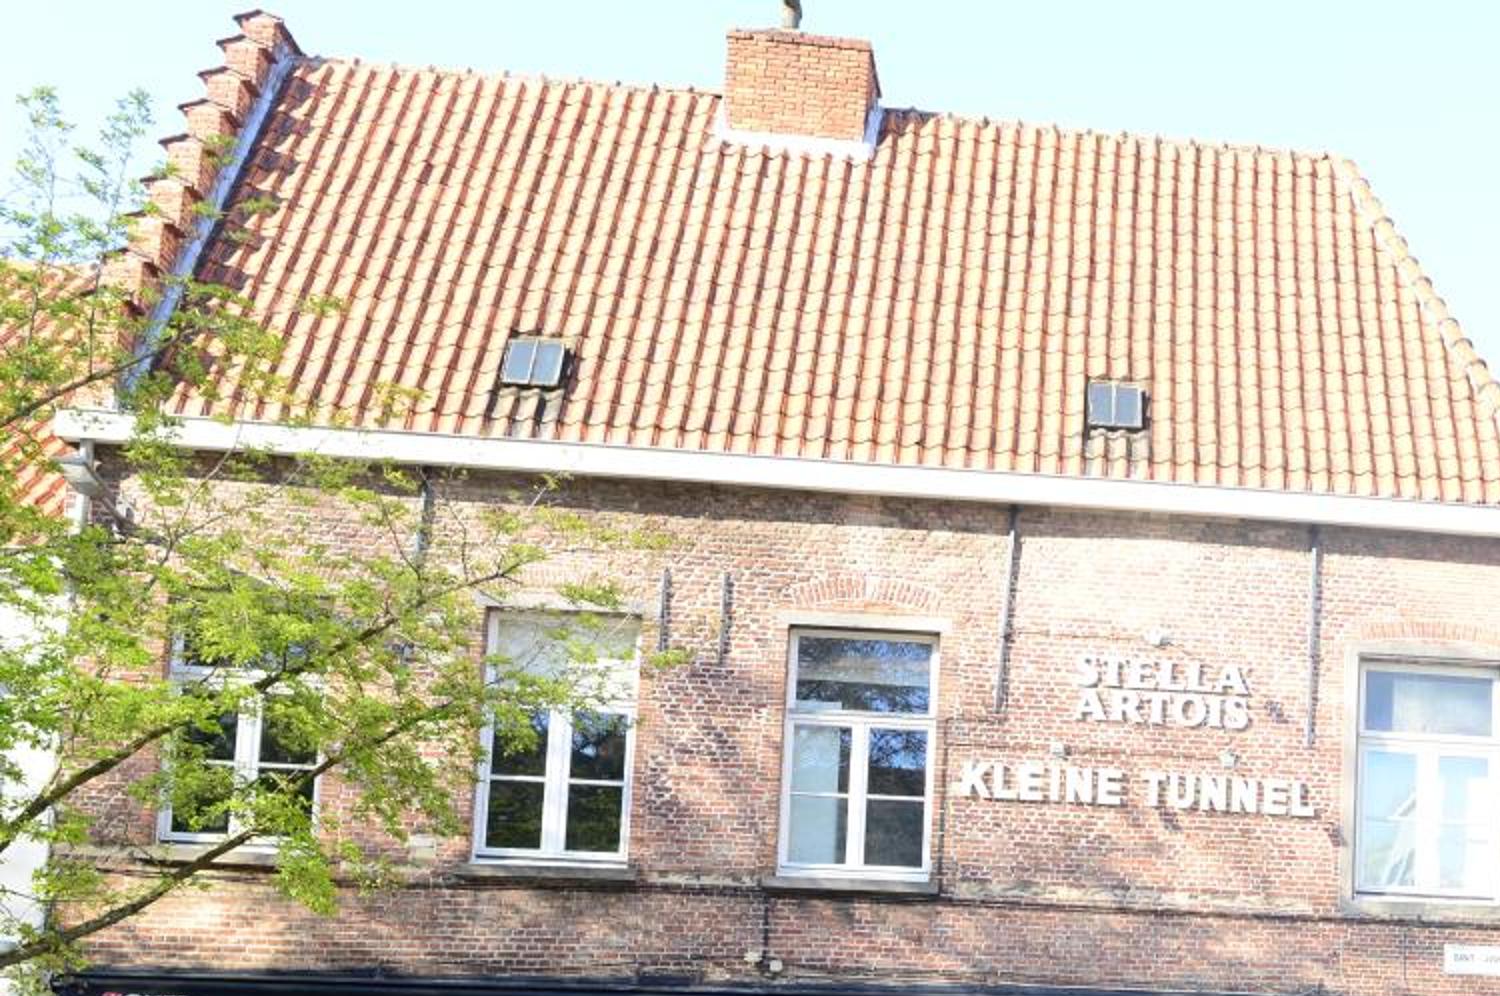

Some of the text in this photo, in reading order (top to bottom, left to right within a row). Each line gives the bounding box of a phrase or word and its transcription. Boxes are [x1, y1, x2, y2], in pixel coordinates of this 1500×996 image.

[1075, 653, 1251, 695] STELLA
[1073, 689, 1251, 731] ARTOIS
[956, 760, 1318, 818] KLEINE TUNNEL
